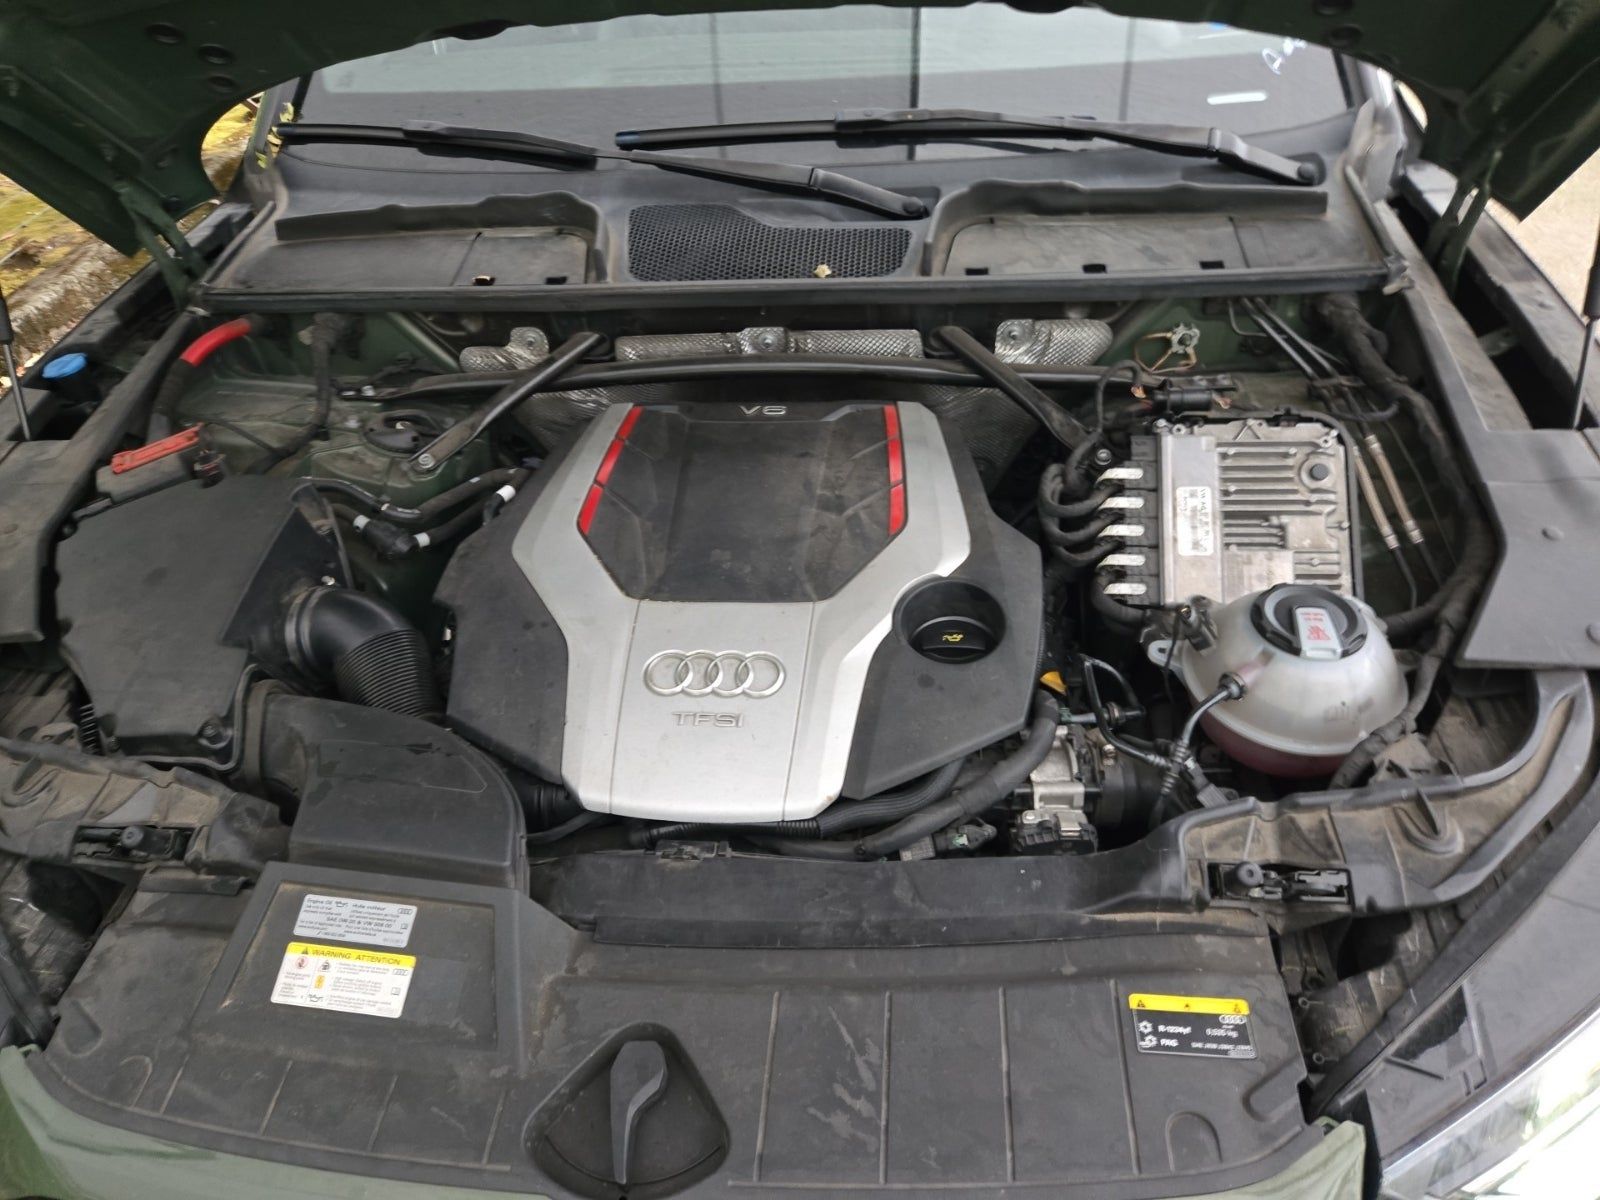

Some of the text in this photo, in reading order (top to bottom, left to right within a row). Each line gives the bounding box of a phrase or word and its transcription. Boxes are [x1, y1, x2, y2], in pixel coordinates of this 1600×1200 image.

[739, 404, 787, 416] V6
[672, 711, 744, 728] TFSI
[312, 949, 401, 966] WARNING ATTENTION
